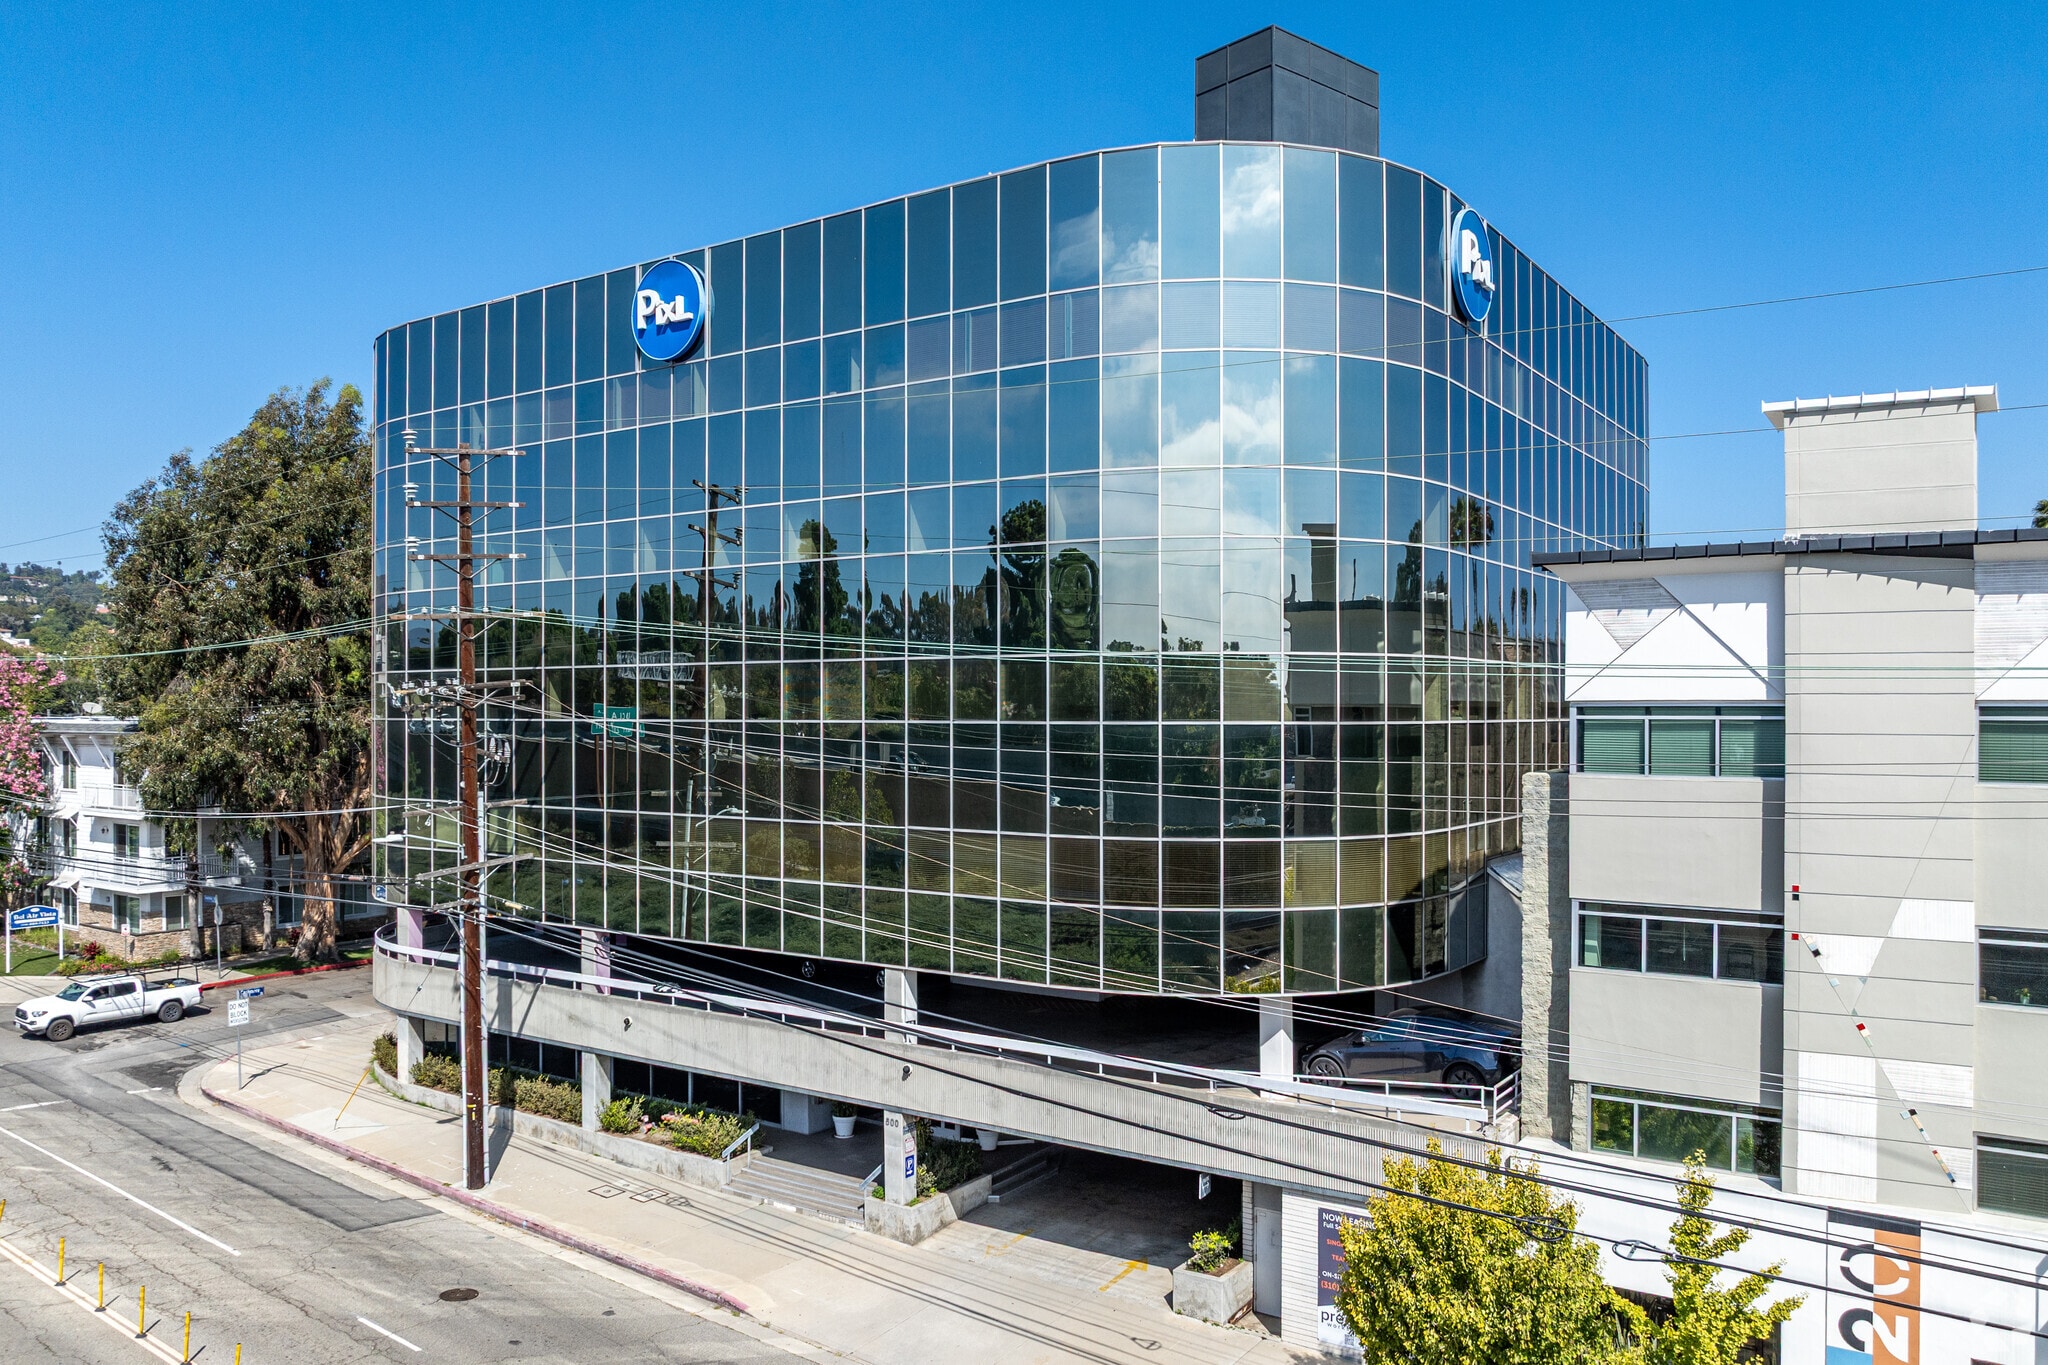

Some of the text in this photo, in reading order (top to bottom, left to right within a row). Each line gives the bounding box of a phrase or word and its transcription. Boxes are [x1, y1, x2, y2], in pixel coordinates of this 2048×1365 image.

[230, 1009, 248, 1019] BLOCK
[1322, 1212, 1342, 1223] NOW
[1320, 1280, 1341, 1293] (310)
